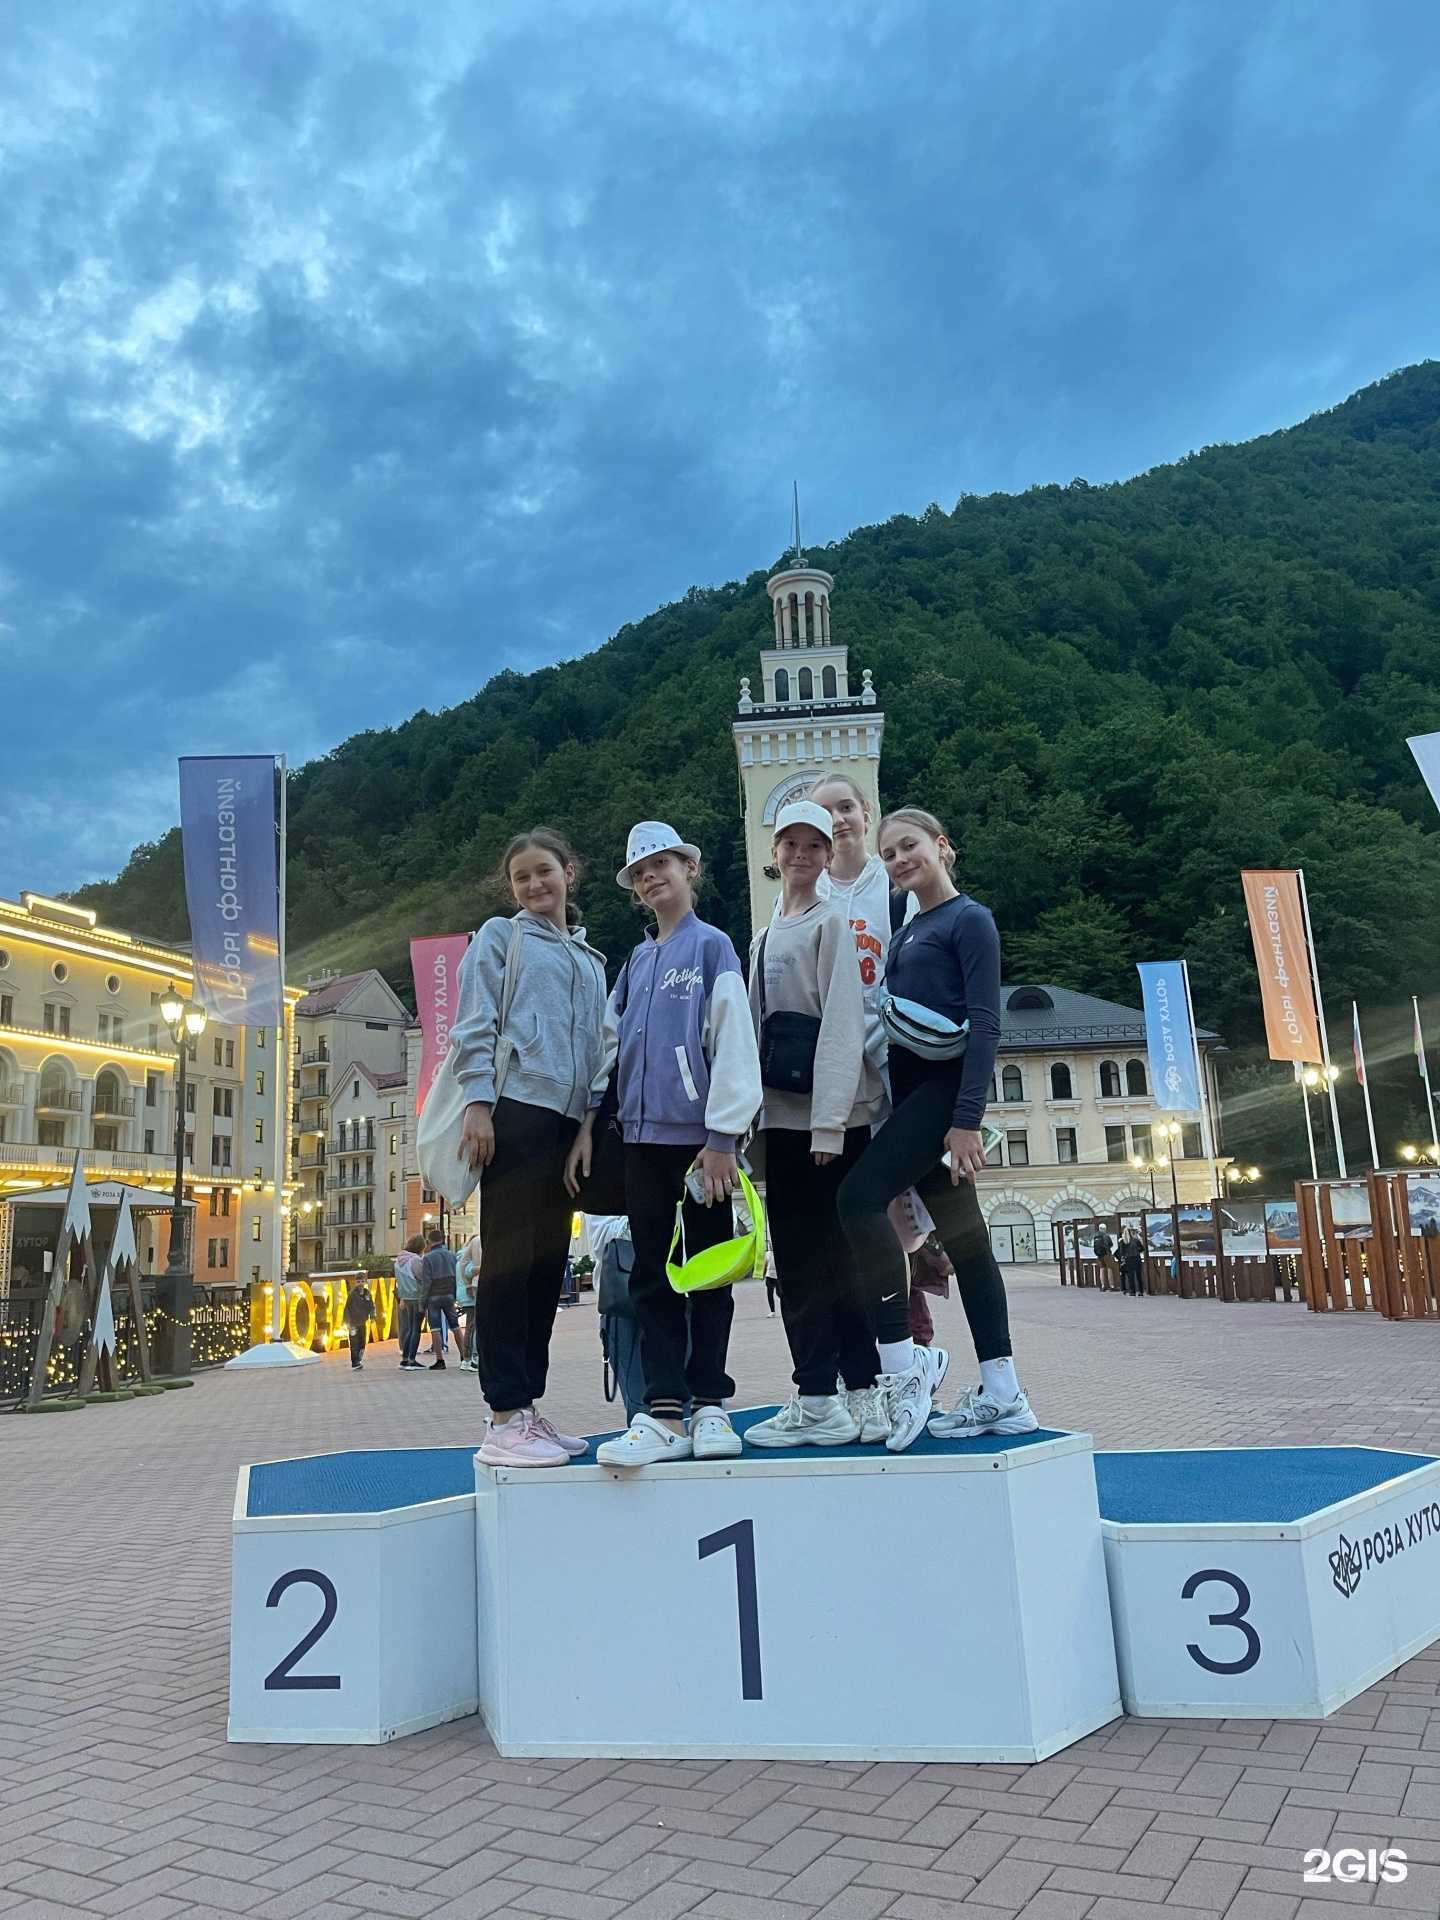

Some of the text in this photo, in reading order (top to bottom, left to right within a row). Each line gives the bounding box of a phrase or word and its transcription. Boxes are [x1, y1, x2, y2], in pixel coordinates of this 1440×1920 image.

[1363, 1523, 1405, 1571] РОЗА
[264, 1568, 341, 1690] 2
[698, 1519, 763, 1700] 1
[1181, 1569, 1261, 1675] 3
